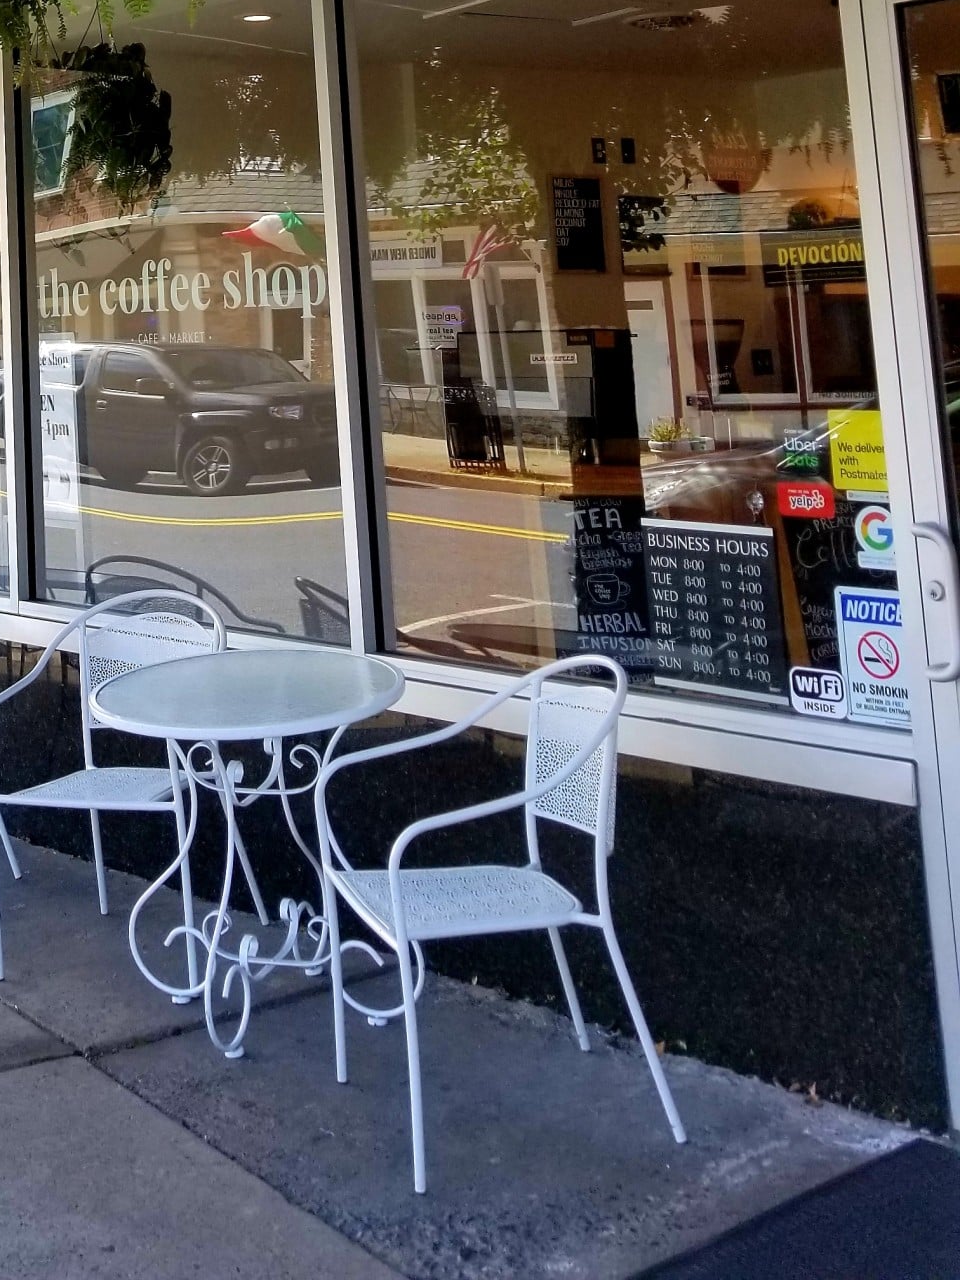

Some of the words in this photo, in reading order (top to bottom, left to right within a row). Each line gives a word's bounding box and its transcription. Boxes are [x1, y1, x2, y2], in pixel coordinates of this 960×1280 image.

[556, 208, 584, 218] ALMOND
[589, 199, 599, 208] FAT
[777, 240, 863, 267] DEVOCIÓN
[36, 268, 90, 320] the
[100, 257, 211, 316] coffee
[223, 251, 327, 320] shop
[138, 333, 159, 345] CAFE
[169, 331, 206, 345] MARKET
[41, 393, 56, 413] EN
[784, 437, 817, 452] Uber
[837, 441, 853, 453] We
[785, 452, 819, 468] Eats
[839, 455, 859, 466] with
[790, 495, 814, 509] yelp
[567, 507, 623, 530] TEA
[647, 532, 710, 552] BUSINESS
[716, 538, 769, 558] HOURS
[650, 555, 678, 569] MON
[683, 558, 705, 571] 8:00
[720, 563, 731, 573] TO
[737, 563, 761, 577] 4:00
[651, 571, 673, 585] TUE
[685, 575, 706, 589] 8:00
[721, 580, 732, 590] TO
[738, 581, 763, 595] 4:00
[652, 588, 679, 603] WED
[686, 592, 707, 606] 8:00
[722, 597, 734, 607] TO
[739, 598, 764, 612] 4:00
[579, 612, 647, 633] HERBAL
[654, 604, 678, 619] THU
[688, 609, 709, 623] 8:00
[724, 615, 735, 625] TO
[741, 615, 766, 630] 4:00
[655, 621, 672, 635] FRI
[690, 626, 712, 640] 8:00
[725, 631, 737, 642] TO
[743, 633, 768, 648] 4:00
[805, 622, 838, 638] Moch
[577, 635, 652, 651] INFUSION
[657, 638, 677, 653] SAT
[691, 643, 713, 657] 8:00
[727, 648, 739, 659] TO
[744, 650, 769, 666] 4:00
[659, 655, 683, 670] SUN
[693, 660, 715, 675] 8:00
[728, 666, 741, 677] TO
[746, 668, 771, 683] 4:00
[852, 681, 867, 694] NO
[869, 683, 909, 700] SMOKIN
[803, 701, 836, 714] INSIDE
[888, 707, 911, 716] ENTRAN
